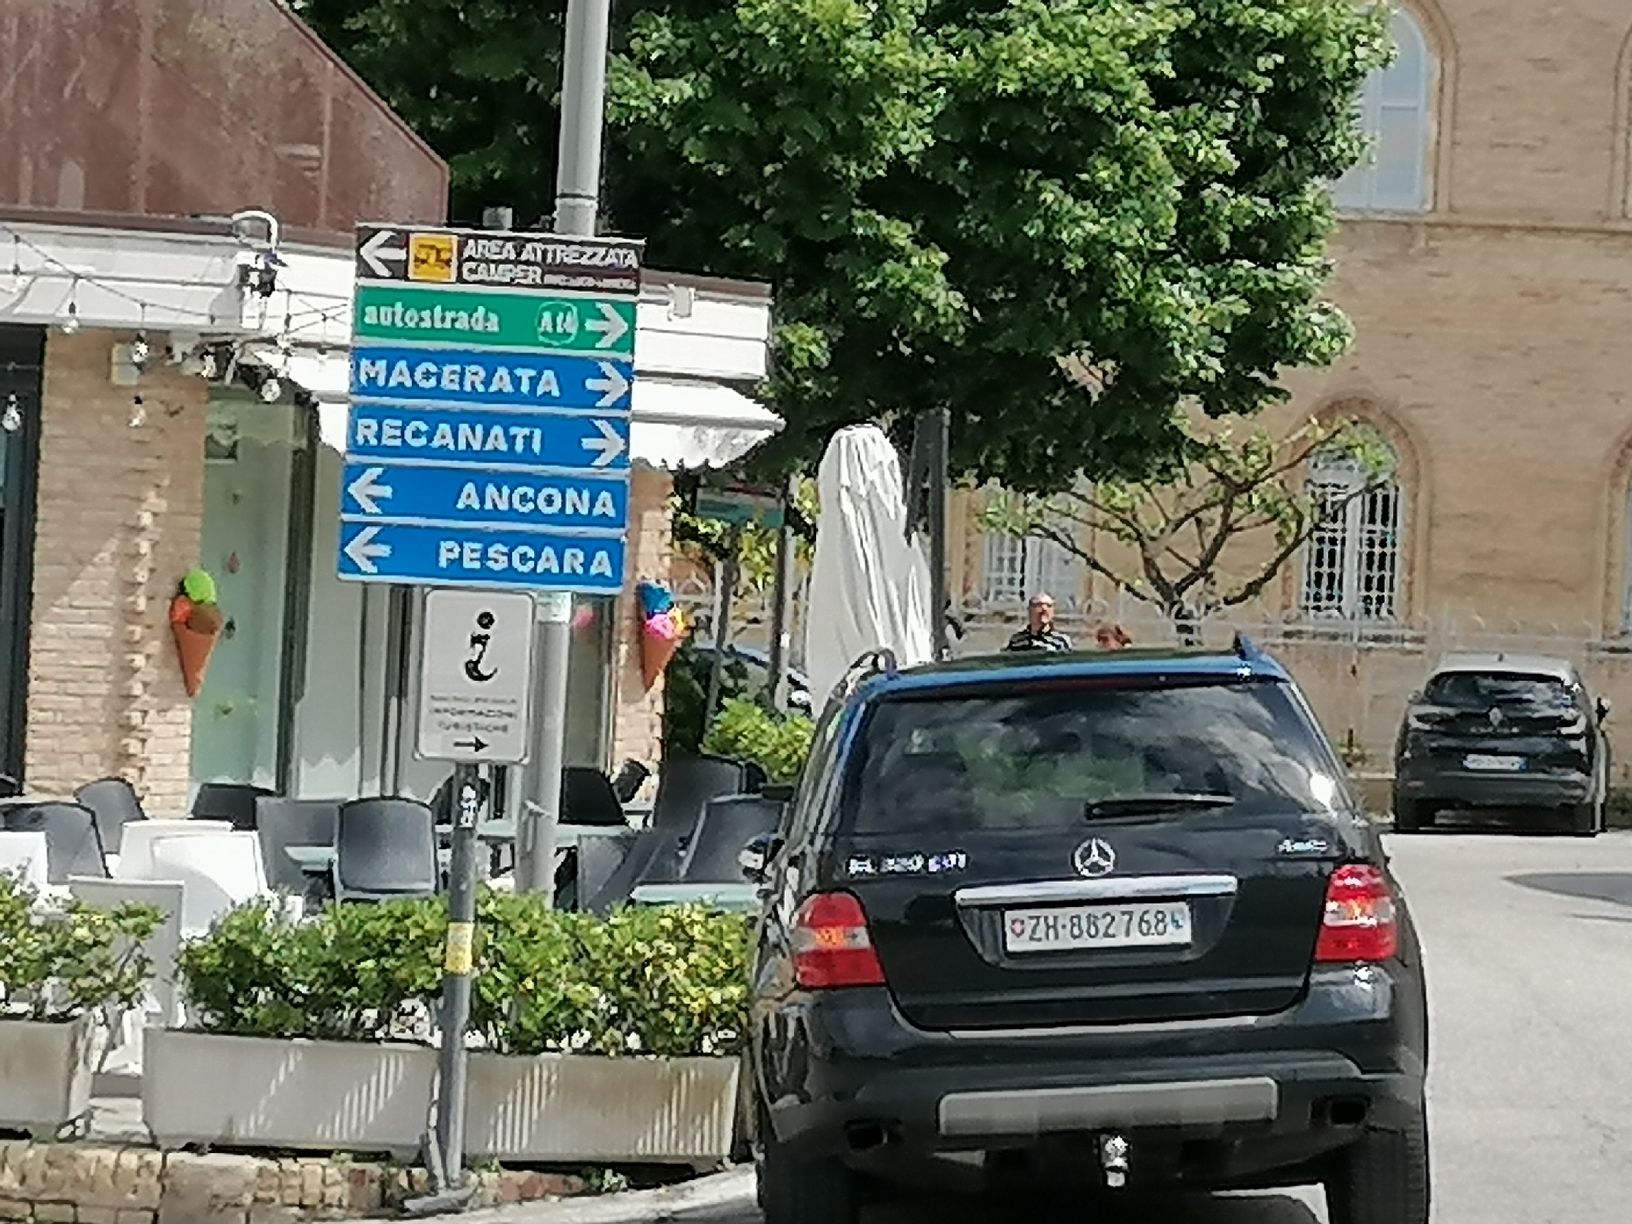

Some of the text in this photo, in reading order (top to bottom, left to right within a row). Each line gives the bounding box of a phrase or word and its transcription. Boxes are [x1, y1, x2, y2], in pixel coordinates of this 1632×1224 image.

[463, 239, 639, 269] AREA ATTREZZATA
[363, 302, 500, 333] autostrada
[358, 357, 561, 398] MACERATA
[355, 418, 543, 456] RECANATI
[456, 481, 616, 518] ANCONA
[438, 540, 613, 578] PESCARA
